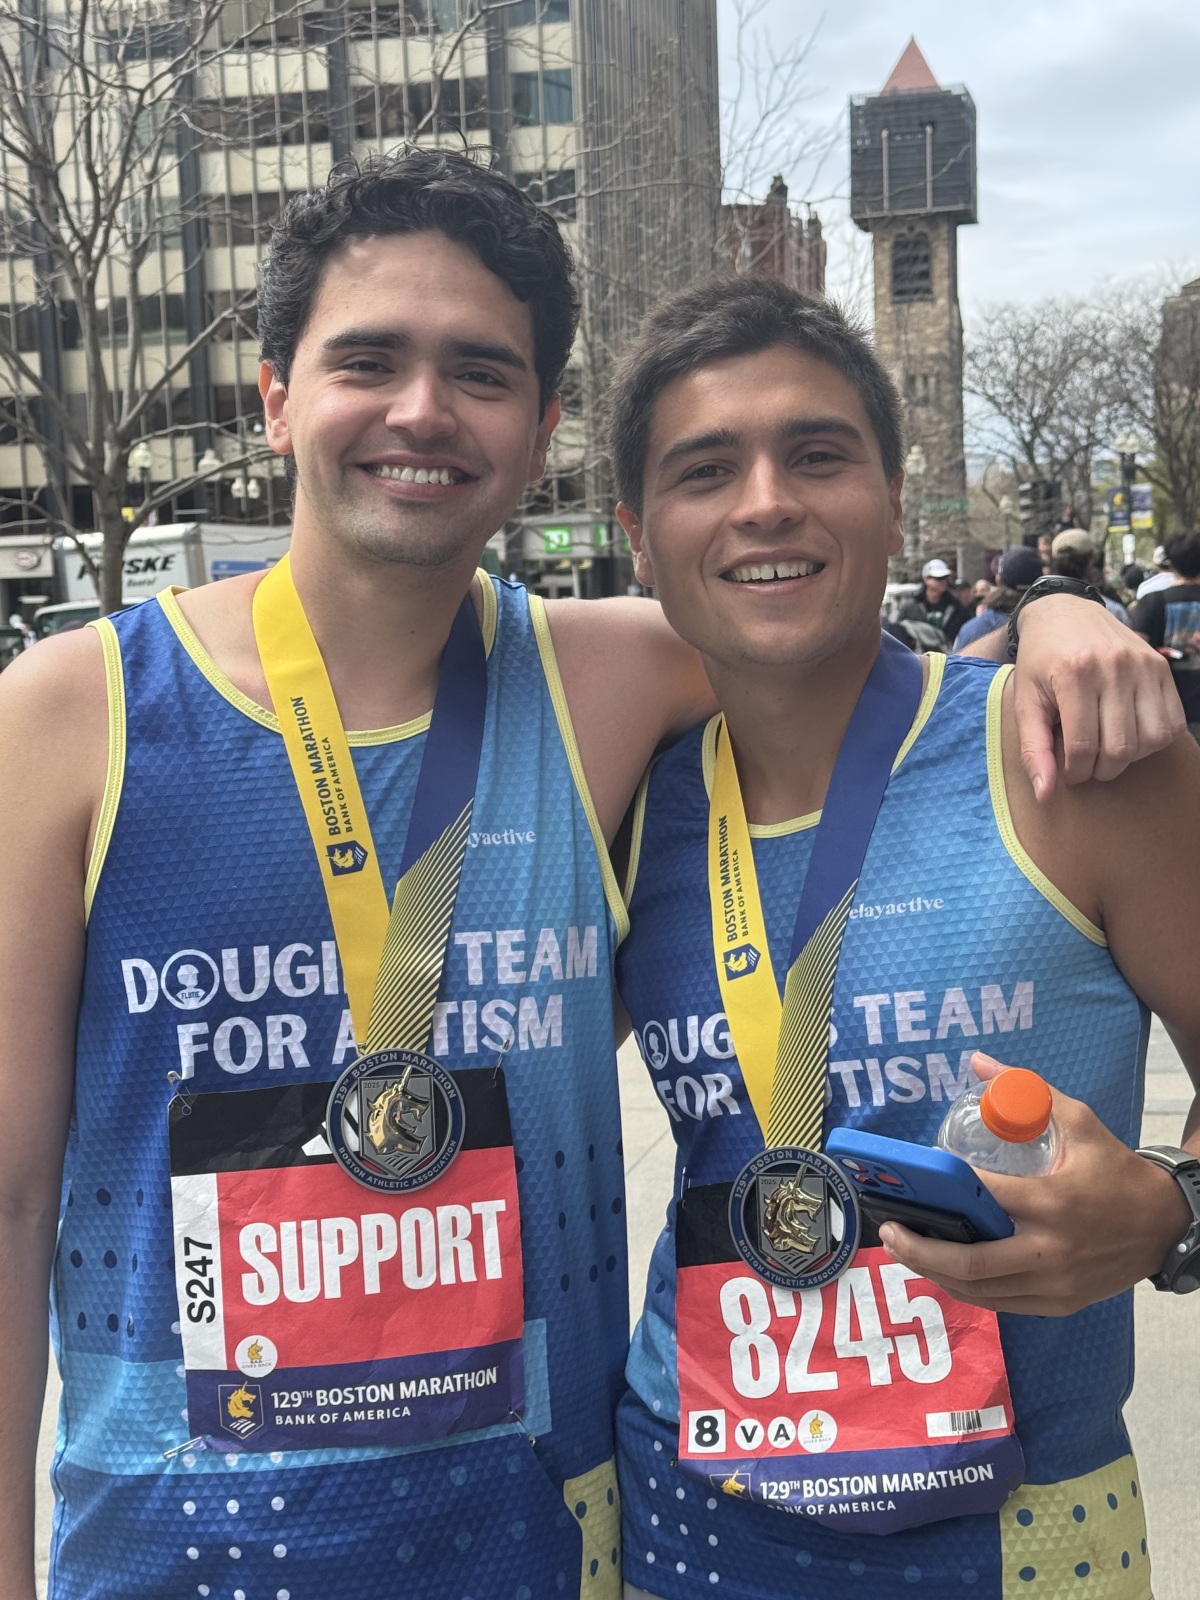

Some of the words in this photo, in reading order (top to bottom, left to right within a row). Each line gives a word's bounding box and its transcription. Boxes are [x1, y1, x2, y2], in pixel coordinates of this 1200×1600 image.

[290, 696, 325, 775] MARATHON
[321, 736, 340, 784] AMERICA
[316, 777, 341, 836] BOSTON
[335, 787, 345, 801] OF
[340, 802, 353, 833] BANK
[719, 815, 731, 887] MARATHON
[732, 849, 744, 893] AMERICA
[722, 888, 738, 943] BOSTON
[737, 895, 745, 908] OF
[738, 909, 749, 937] BANK
[454, 925, 598, 987] TEAM
[176, 1014, 310, 1080] FOR
[332, 994, 564, 1065] ATISM
[853, 981, 1035, 1045] TEAM
[335, 1078, 349, 1106] 129TH
[351, 1053, 398, 1078] BOSTON
[402, 1053, 457, 1099] MARATHON
[656, 1073, 742, 1122] FOR
[824, 1049, 981, 1108] TISM
[338, 1146, 366, 1177] BOSTON
[367, 1175, 410, 1188] ATHLETIC
[412, 1140, 457, 1186] ASSOCIATION
[734, 1173, 749, 1198] 129TH
[749, 1150, 793, 1174] BOSTON
[797, 1151, 850, 1201] MARATHON
[239, 1199, 507, 1306] SUPPORT
[738, 1239, 765, 1273] BOSTON
[765, 1271, 805, 1287] ATHLETIC
[808, 1243, 851, 1285] ASSOCIATION
[184, 1237, 217, 1324] S247
[719, 1263, 953, 1399] 8245
[271, 1390, 313, 1409] 129TH
[315, 1383, 394, 1407] BOSTON
[399, 1366, 498, 1400] MARATHON
[275, 1413, 316, 1426] BANK
[319, 1412, 339, 1424] OF
[342, 1406, 412, 1423] AMERICA
[694, 1415, 720, 1447] 8
[740, 1425, 758, 1443] V
[773, 1423, 791, 1442] A
[760, 1480, 800, 1500] 129TH
[802, 1475, 878, 1499] BOSTON
[882, 1463, 994, 1494] MARATHON
[806, 1504, 825, 1515] OF
[828, 1499, 897, 1515] AMERICA
